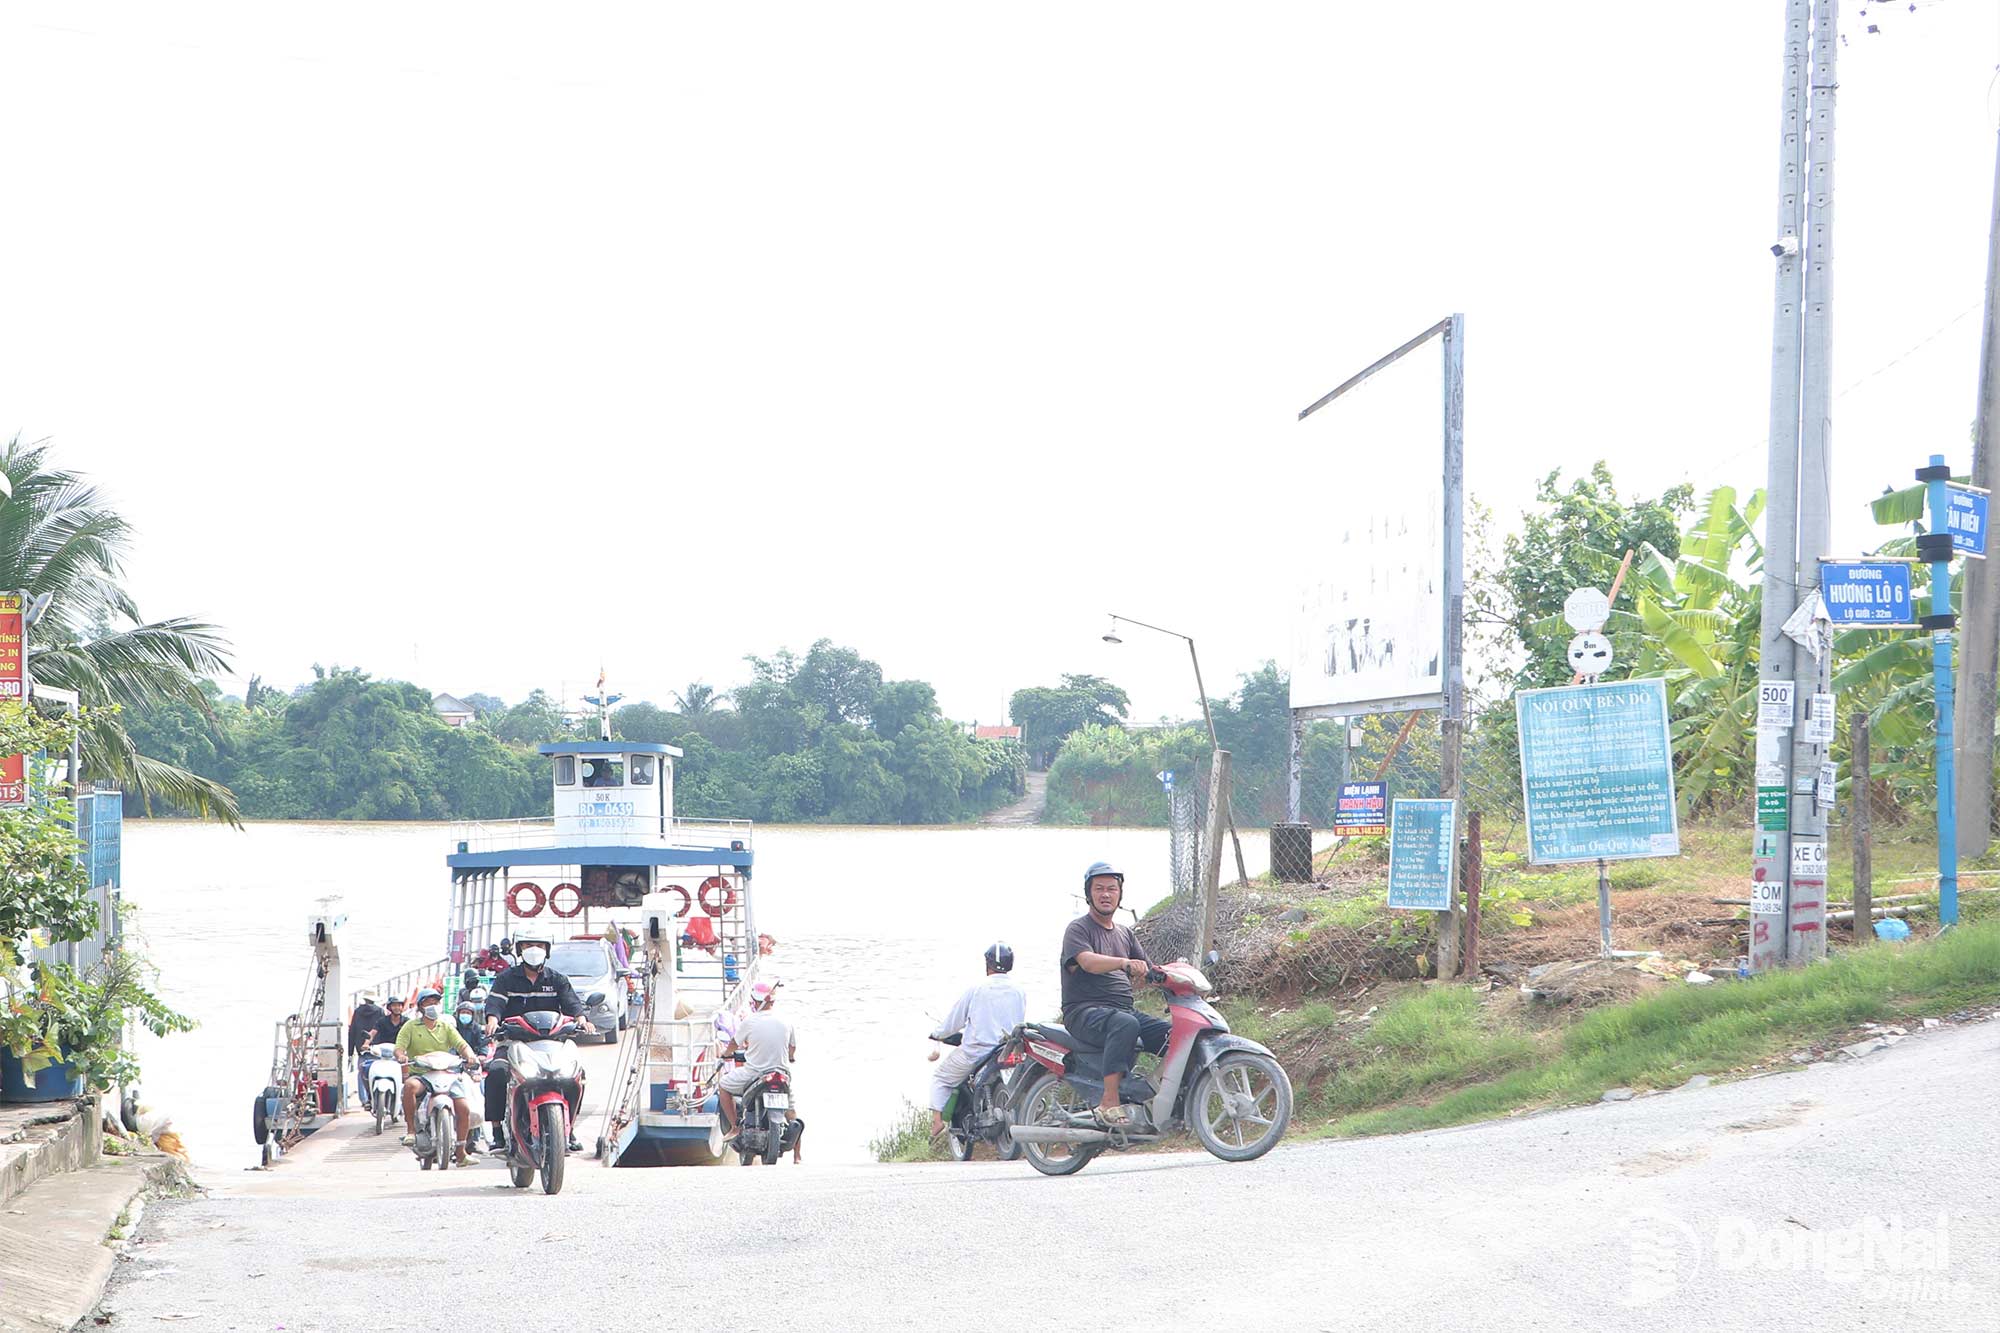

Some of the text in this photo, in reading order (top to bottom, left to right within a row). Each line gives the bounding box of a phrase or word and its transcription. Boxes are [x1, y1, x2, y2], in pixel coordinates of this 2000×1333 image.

[1946, 506, 1960, 528] ÂN
[1849, 568, 1882, 579] ĐƯỜNG
[1830, 580, 1903, 608] HƯƠNG LỘ 6
[1844, 608, 1854, 620] LỘ
[1584, 640, 1596, 649] 8m
[1762, 688, 1787, 702] 500
[1532, 698, 1558, 716] NỘI
[1562, 696, 1593, 714] QUY
[1596, 691, 1626, 708] BẾN
[1540, 842, 1559, 855] Xin
[1794, 847, 1810, 861] XE
[1752, 885, 1758, 899] E
